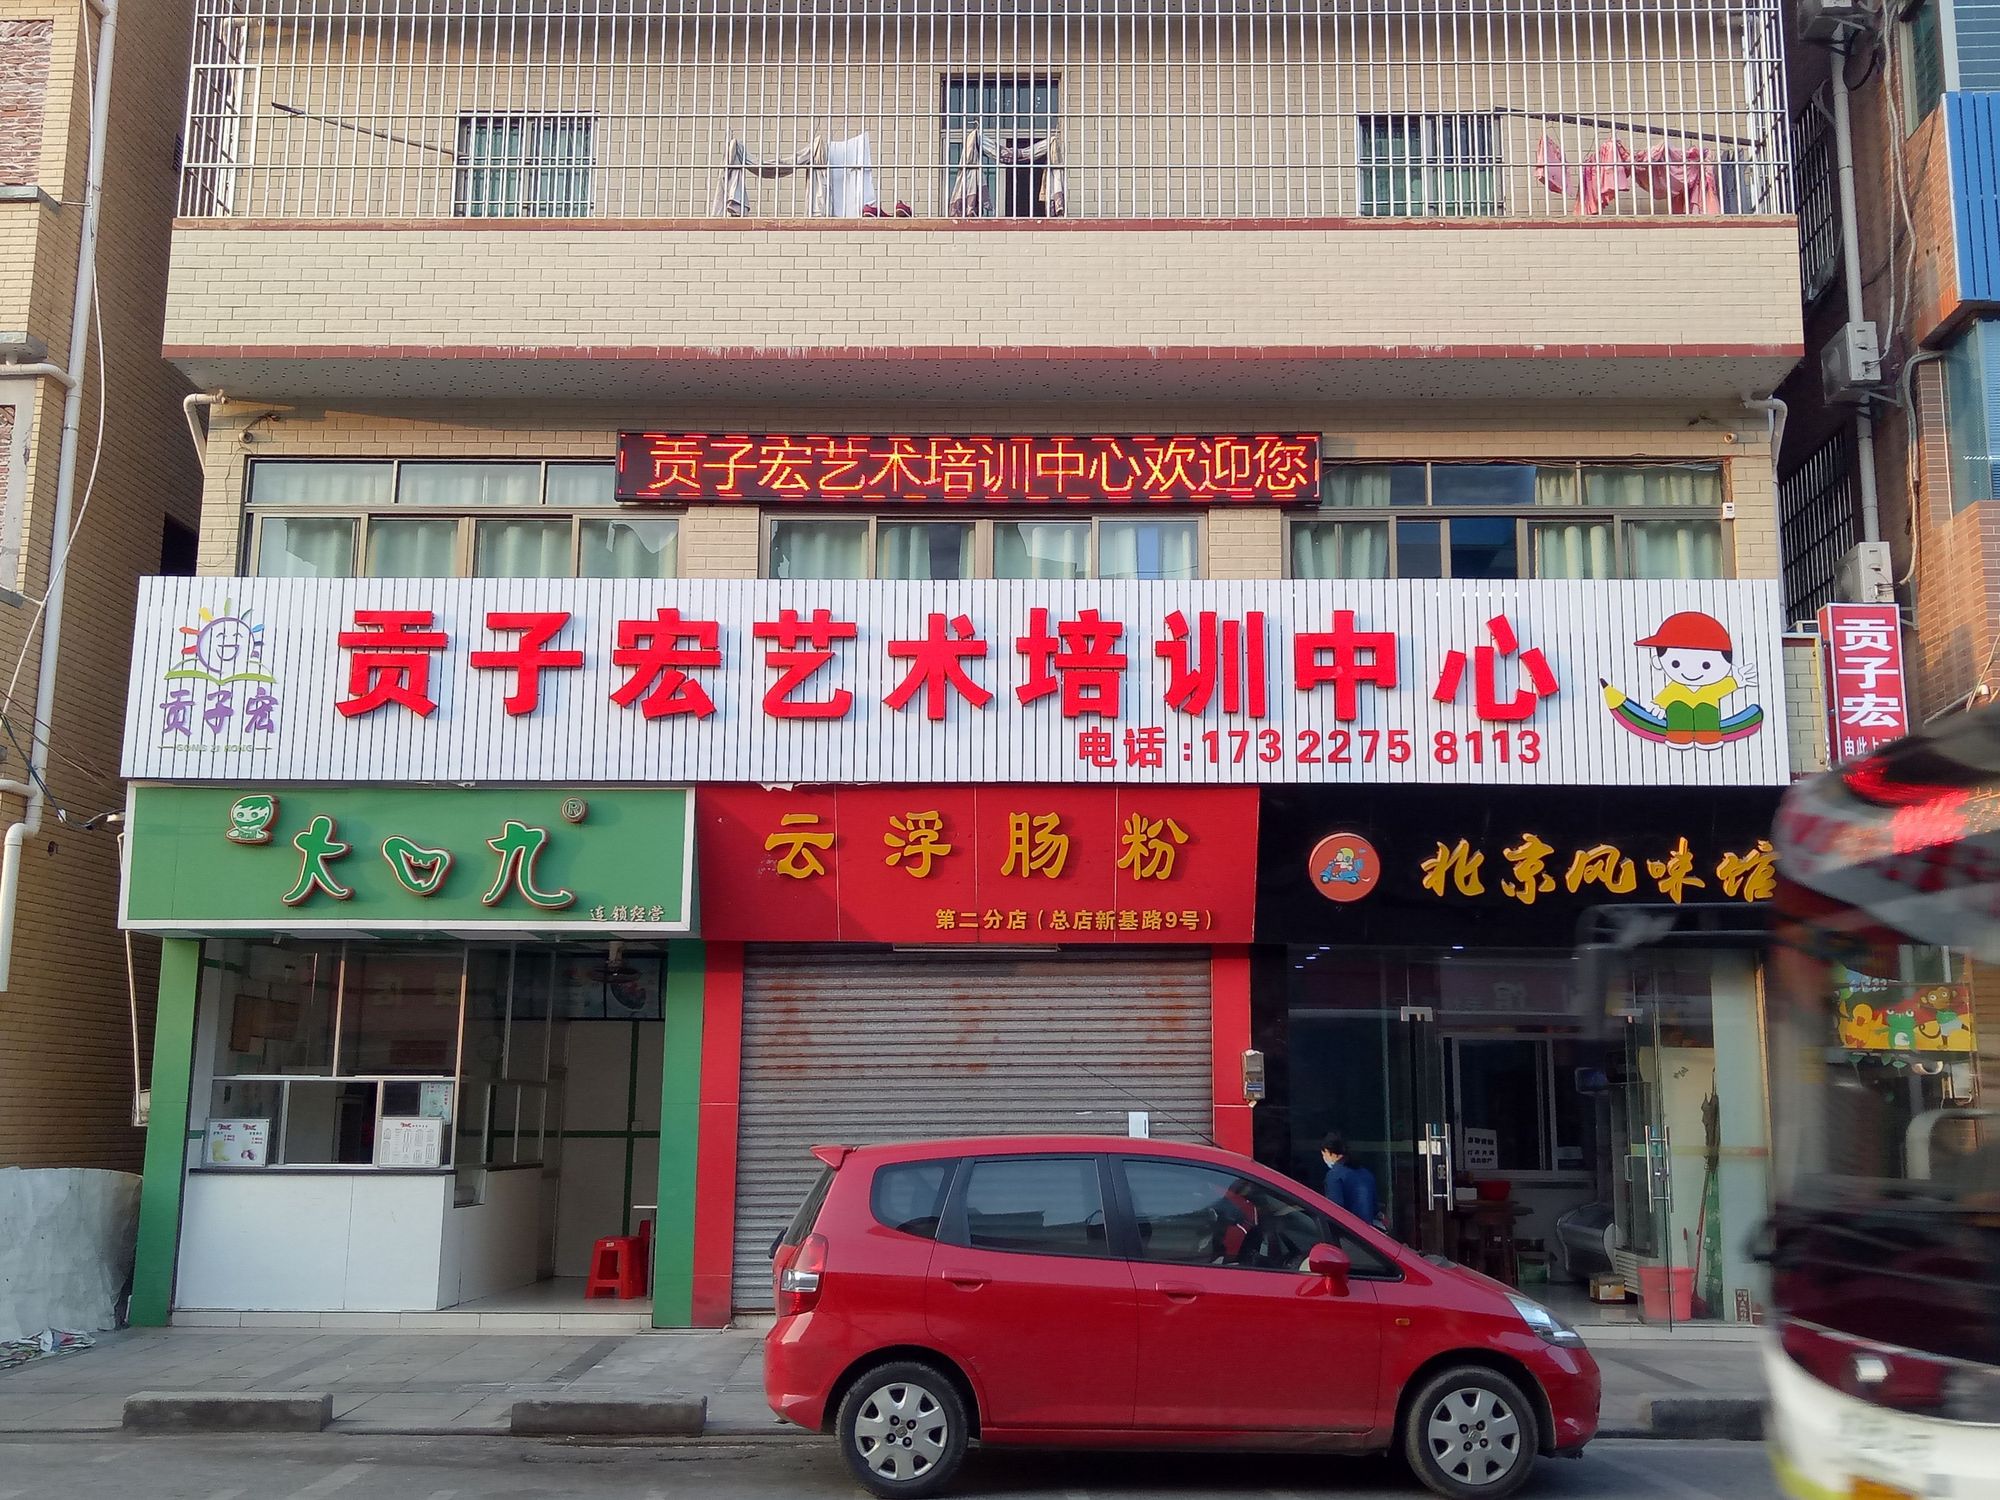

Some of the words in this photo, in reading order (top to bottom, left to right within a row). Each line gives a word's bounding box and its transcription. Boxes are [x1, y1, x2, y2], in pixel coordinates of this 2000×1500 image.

[648, 439, 1308, 494] 贡子宏艺术培训中心欢迎您
[335, 606, 1560, 722] 贡子宏艺术培训中心
[1835, 617, 1901, 728] 贡子宏
[159, 687, 279, 736] 贡子宏
[281, 813, 578, 911] 大口九
[765, 810, 1190, 881] 云浮肠粉
[1419, 832, 1781, 904] 北京风味馆
[589, 904, 665, 922] 连锁经营
